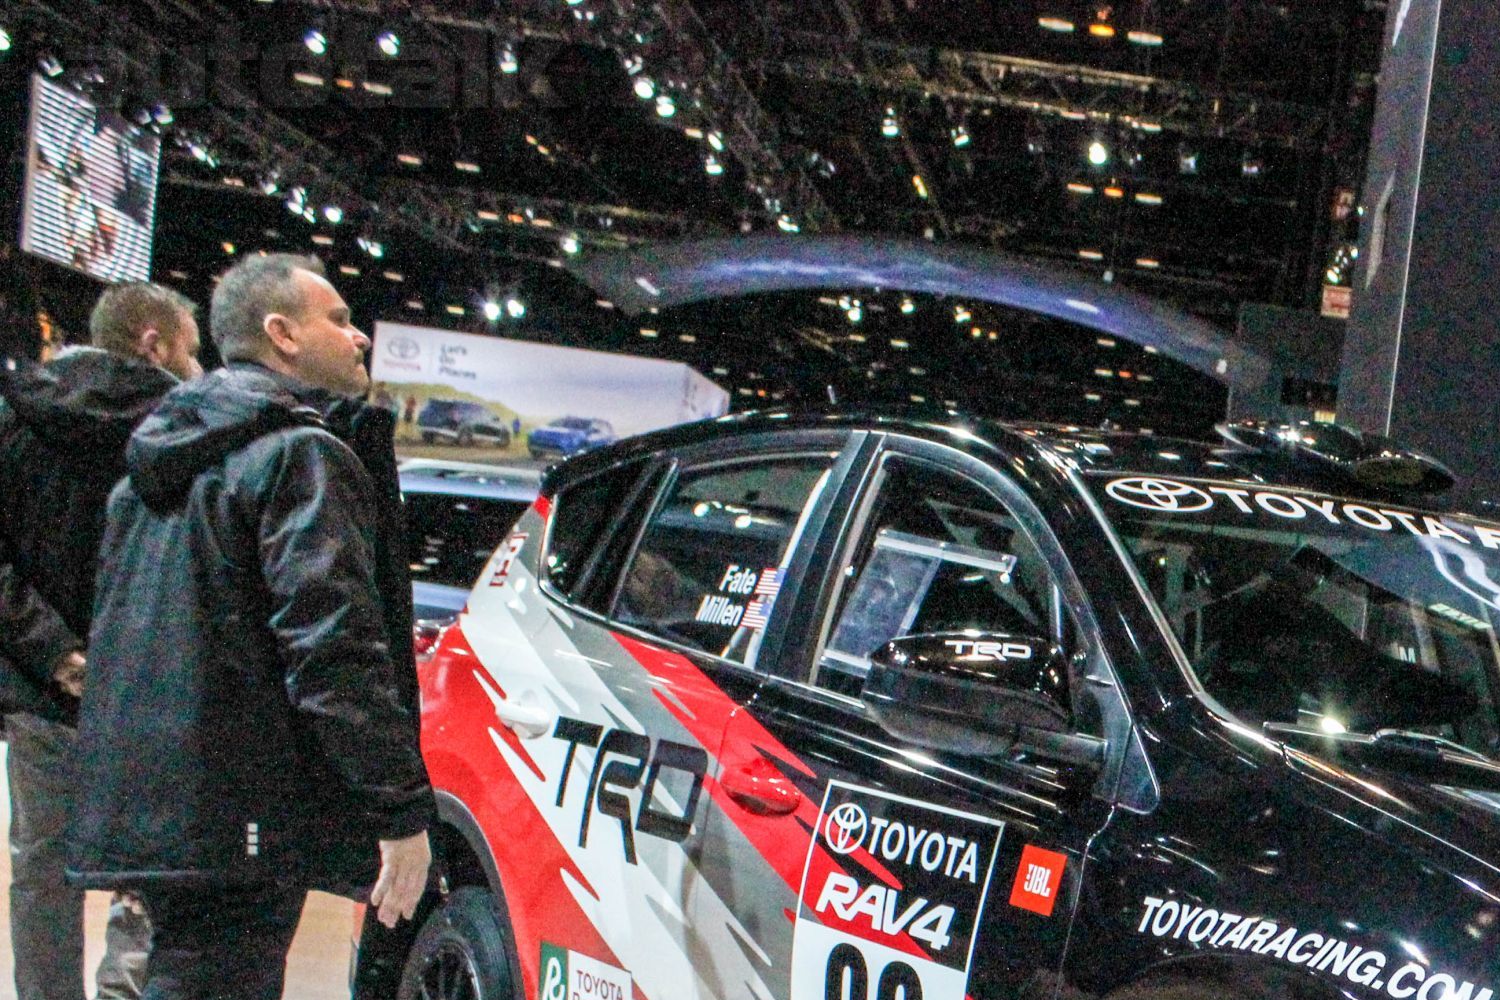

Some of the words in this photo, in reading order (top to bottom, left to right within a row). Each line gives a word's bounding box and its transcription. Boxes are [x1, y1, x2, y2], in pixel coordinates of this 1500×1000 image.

[1209, 487, 1470, 544] TOYOTA
[719, 564, 757, 594] Fate
[695, 594, 744, 627] Millen
[945, 640, 1031, 661] TRD
[553, 715, 708, 866] TRD
[868, 816, 979, 883] TOYOTA
[1023, 863, 1052, 897] JBL
[815, 871, 955, 951] RAV4
